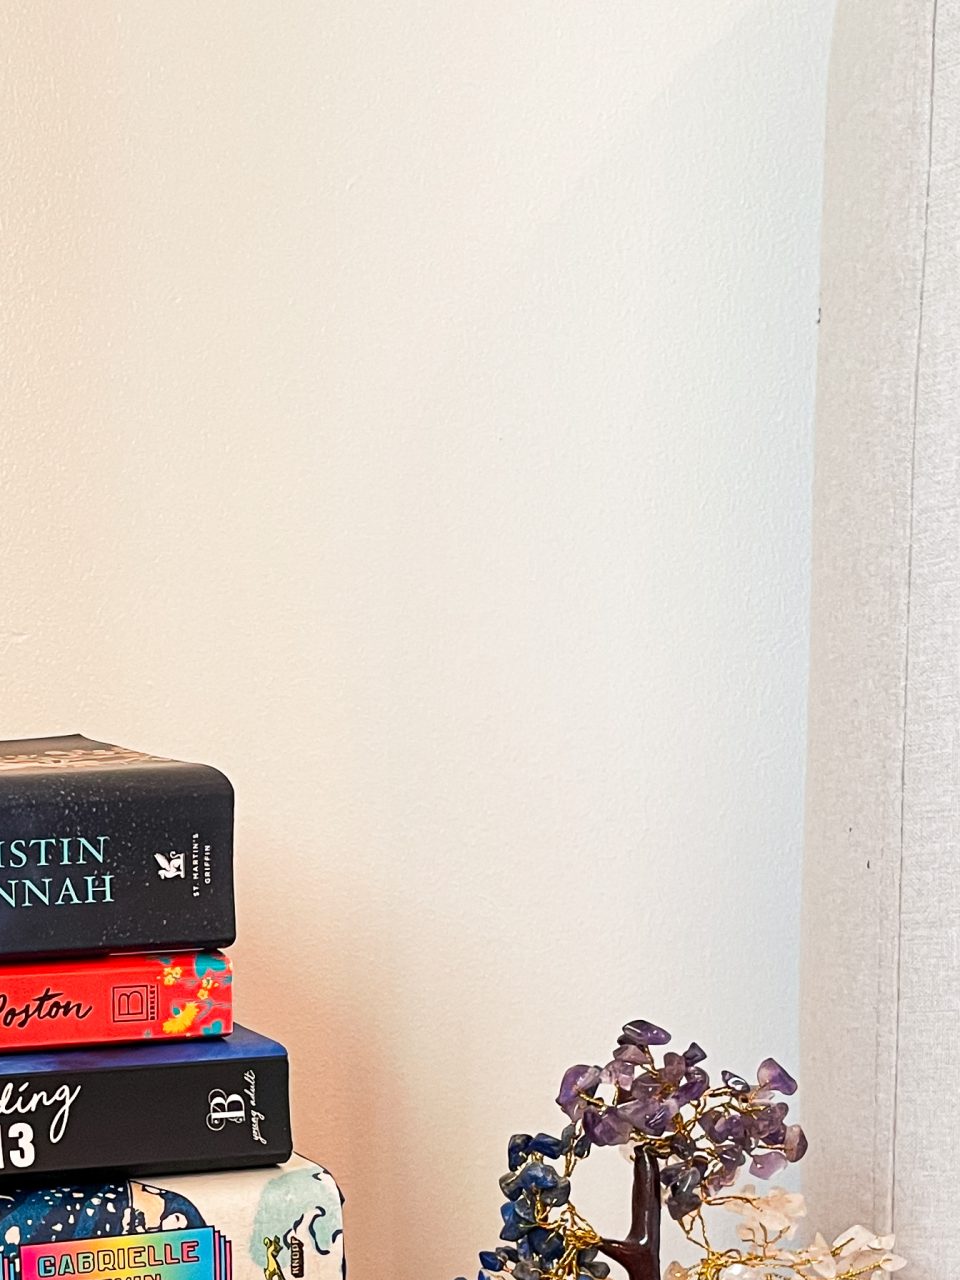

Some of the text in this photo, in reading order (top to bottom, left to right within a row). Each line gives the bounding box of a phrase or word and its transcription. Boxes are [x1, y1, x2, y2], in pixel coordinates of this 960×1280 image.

[192, 833, 200, 880] MARTIN'S
[203, 845, 211, 884] GRIFFIN
[243, 1069, 256, 1107] adult
[37, 1240, 201, 1278] GABRIELLE
